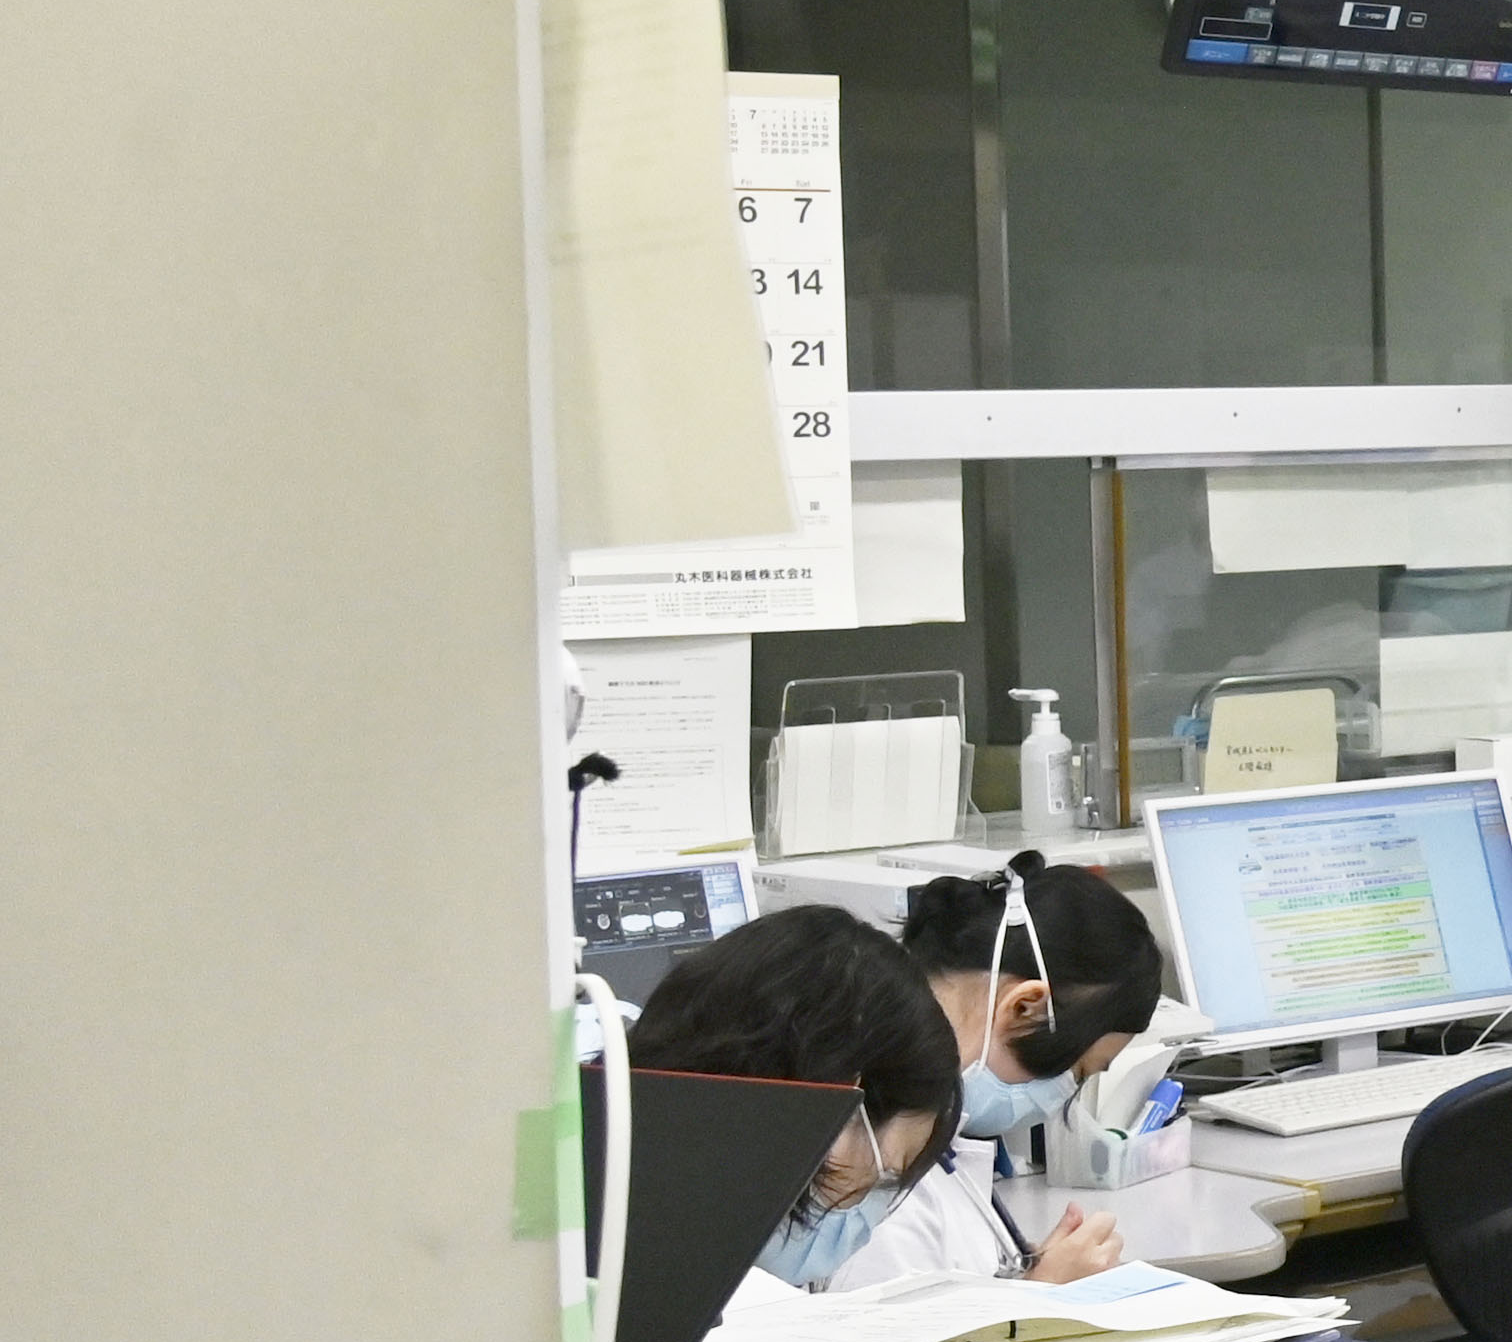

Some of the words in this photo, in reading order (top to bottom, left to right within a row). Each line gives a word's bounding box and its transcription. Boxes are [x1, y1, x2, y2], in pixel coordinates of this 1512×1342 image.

[738, 196, 757, 223] 6
[794, 197, 813, 224] 7
[787, 269, 824, 295] 14
[791, 340, 826, 366] 21
[793, 411, 831, 438] 28
[675, 568, 814, 584] 丸木医科器械株式会社
